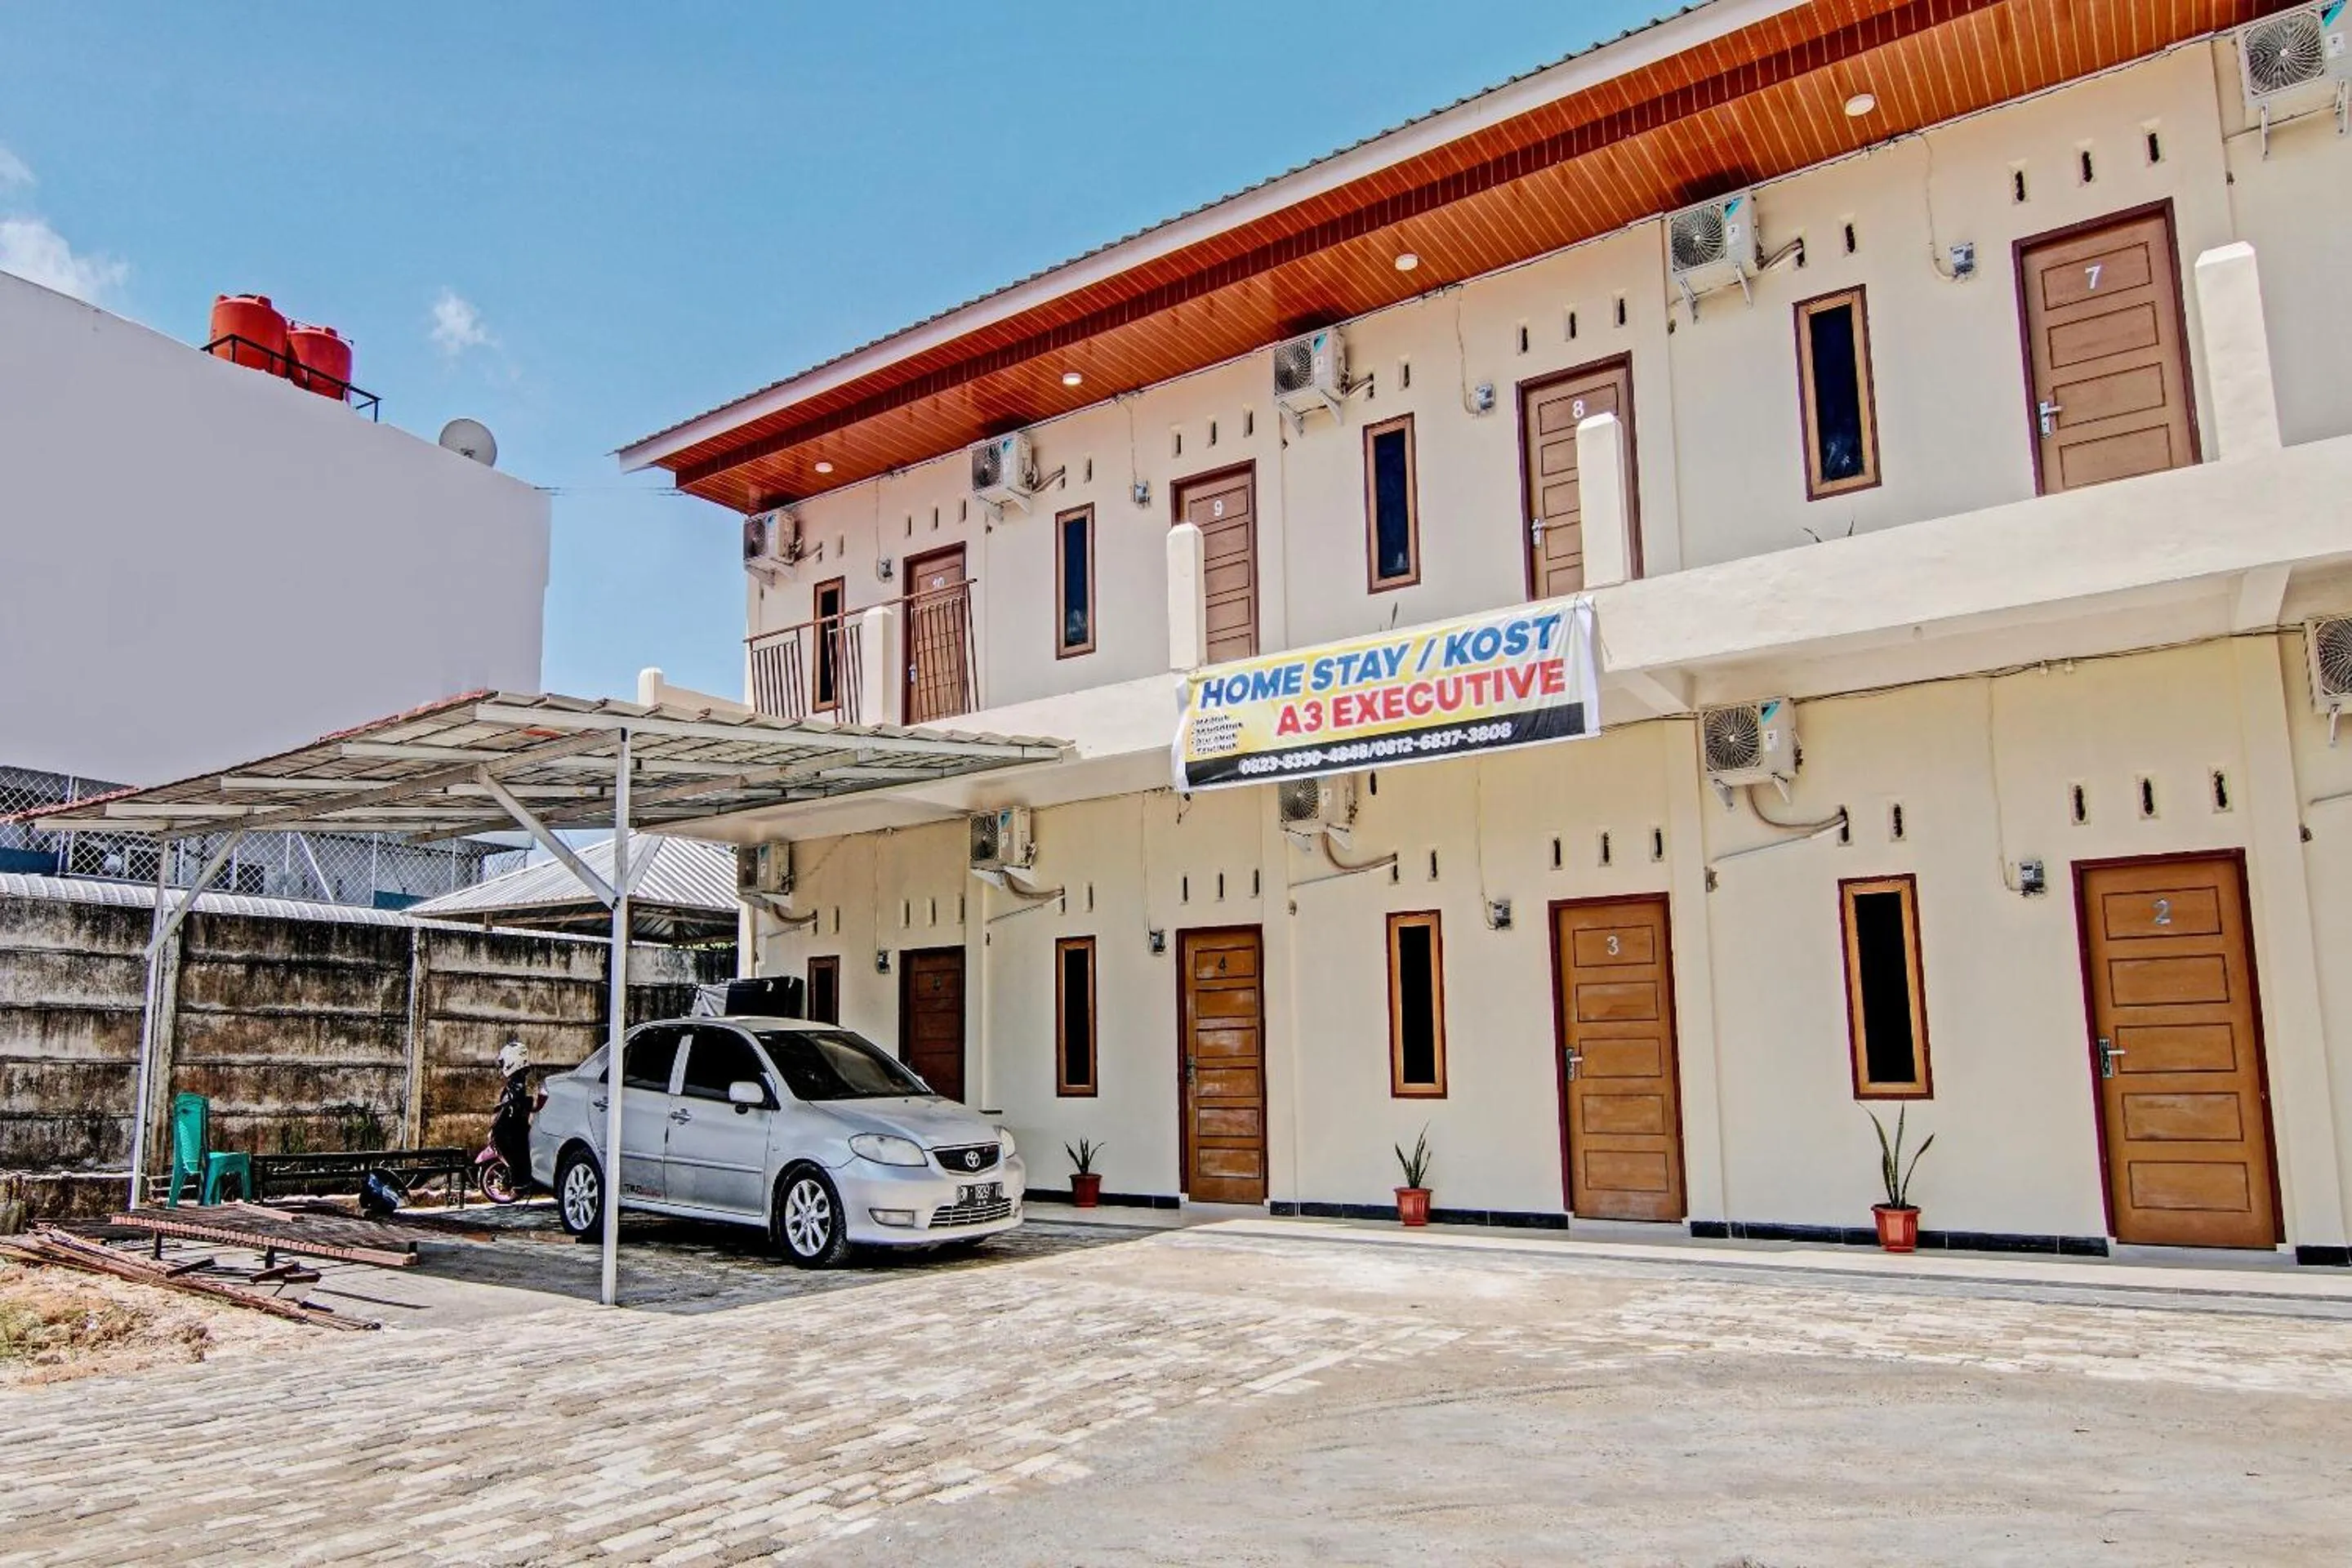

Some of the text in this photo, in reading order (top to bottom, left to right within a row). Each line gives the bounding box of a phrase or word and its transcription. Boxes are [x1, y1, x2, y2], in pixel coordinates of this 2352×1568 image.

[2084, 265, 2101, 289] 7
[1573, 400, 1585, 418] 8
[1214, 501, 1223, 516] 9
[1200, 614, 1561, 709] HOME STAY / KOST
[1276, 657, 1566, 736] A3 EXECUTIVE
[2153, 899, 2171, 925] 2
[1606, 935, 1619, 956] 3
[1218, 954, 1228, 971] 4
